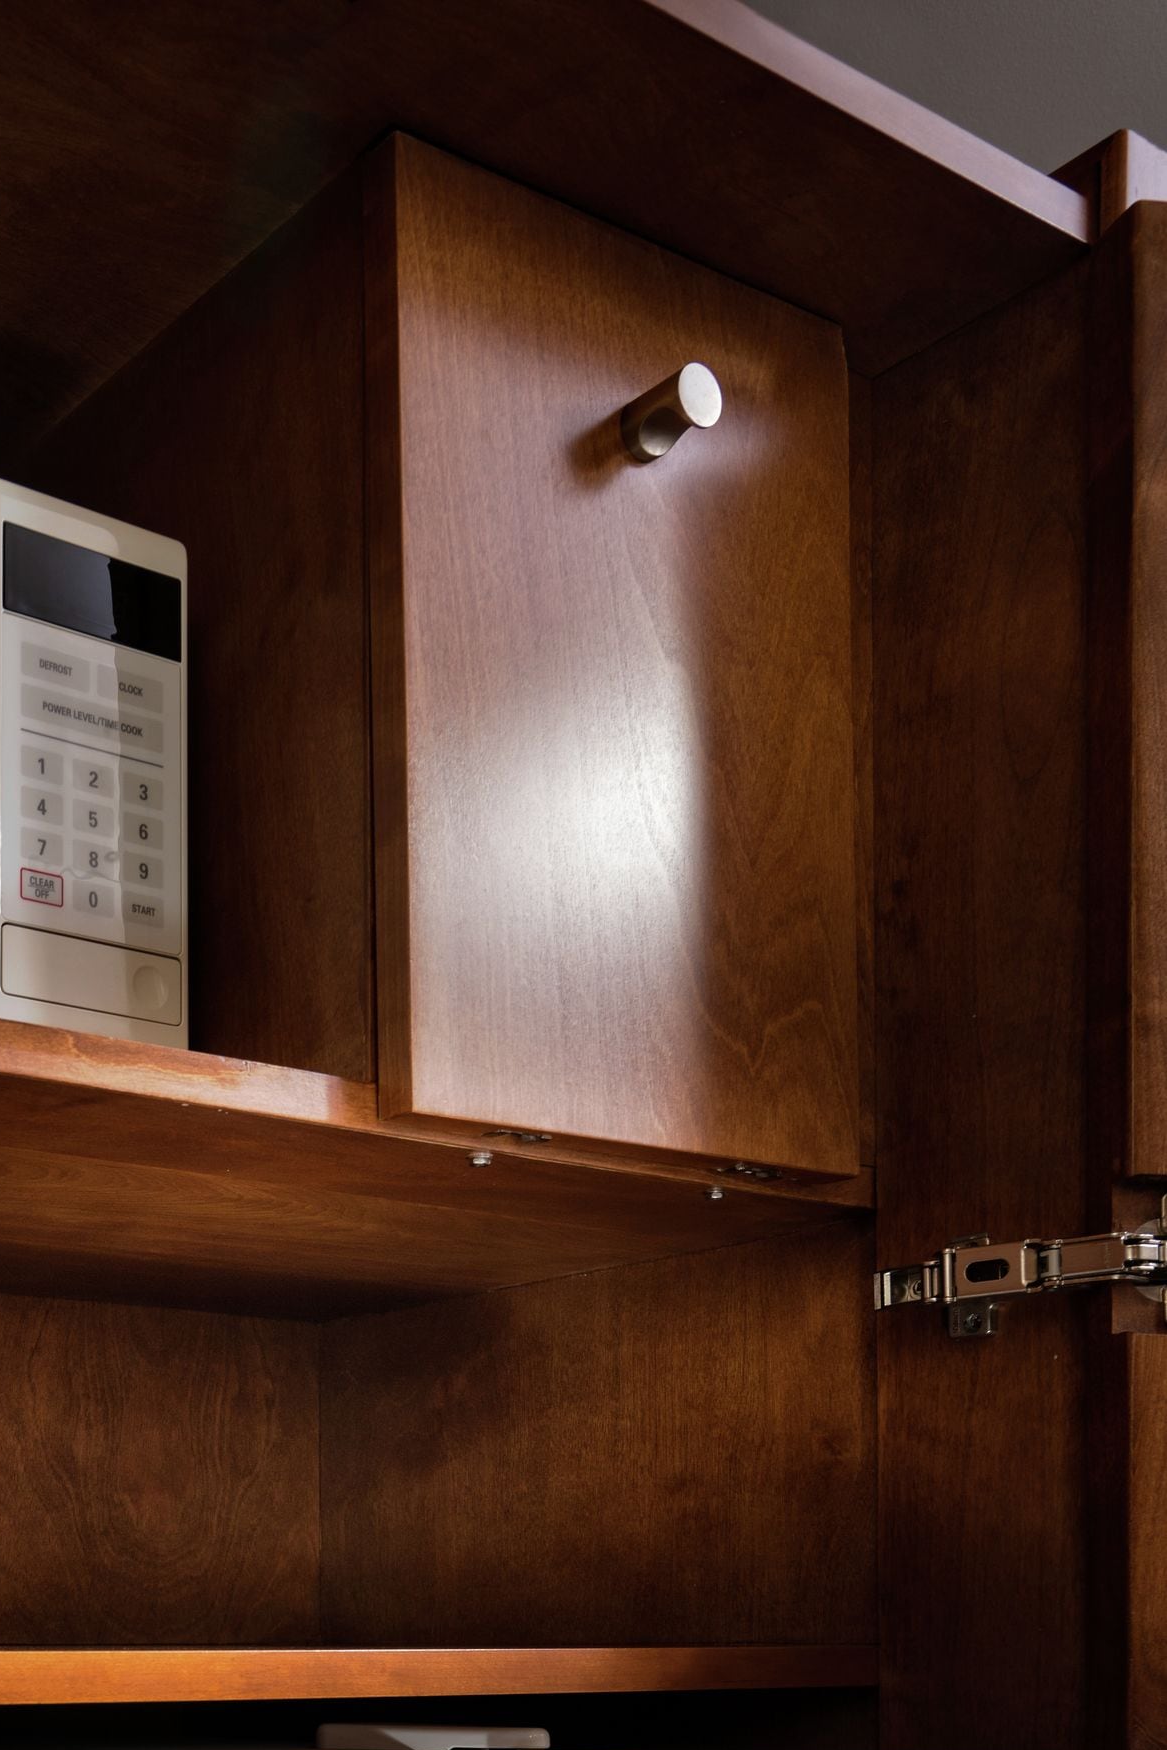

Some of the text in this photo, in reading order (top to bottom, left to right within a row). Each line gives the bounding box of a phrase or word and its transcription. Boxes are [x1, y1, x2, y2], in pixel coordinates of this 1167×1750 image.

[39, 658, 73, 677] DEFROST
[118, 682, 144, 697] CLOCK
[42, 701, 72, 718] POWER
[120, 723, 144, 737] COOK
[38, 757, 45, 775] 1
[89, 771, 99, 789] 2
[139, 784, 149, 801] 3
[37, 798, 47, 816] 4
[89, 811, 99, 828] 5
[139, 824, 149, 840] 6
[37, 838, 47, 856] 7
[89, 851, 99, 868] 8
[139, 863, 149, 880] 9
[29, 876, 55, 889] CLEAR
[34, 889, 50, 899] OFF
[89, 891, 99, 908] 0
[131, 904, 156, 917] START
